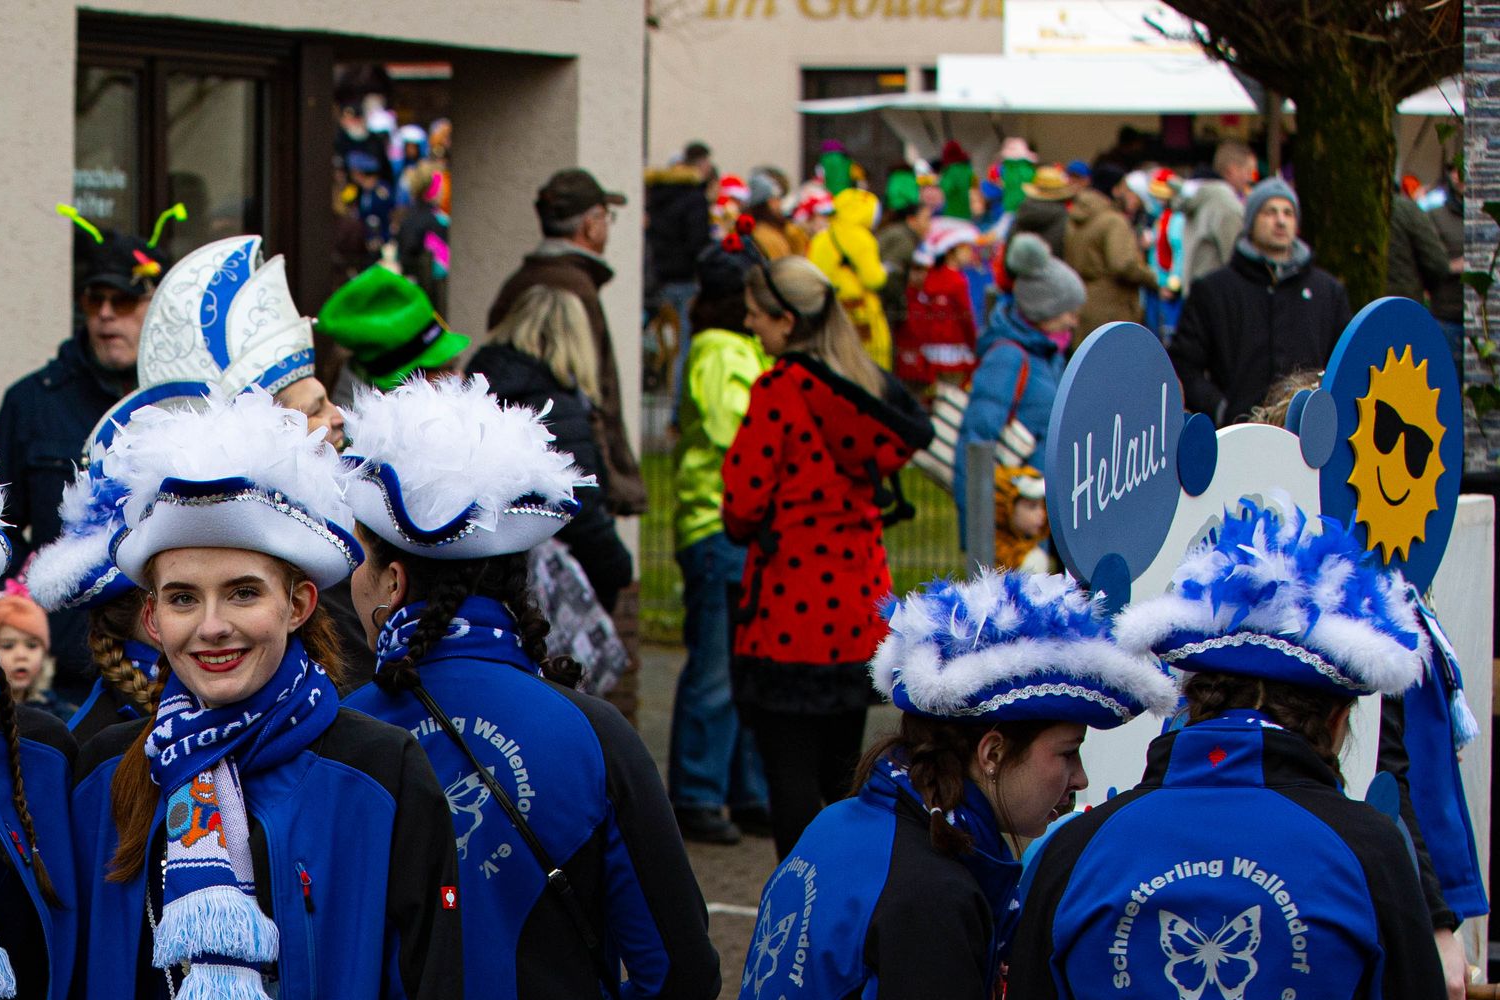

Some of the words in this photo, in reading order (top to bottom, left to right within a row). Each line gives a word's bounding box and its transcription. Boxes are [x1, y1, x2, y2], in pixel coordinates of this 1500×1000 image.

[1071, 381, 1168, 530] Helau!
[788, 863, 818, 989] Wallendorf
[1109, 859, 1224, 990] Schmetterling
[1231, 856, 1311, 975] Wallendorf
